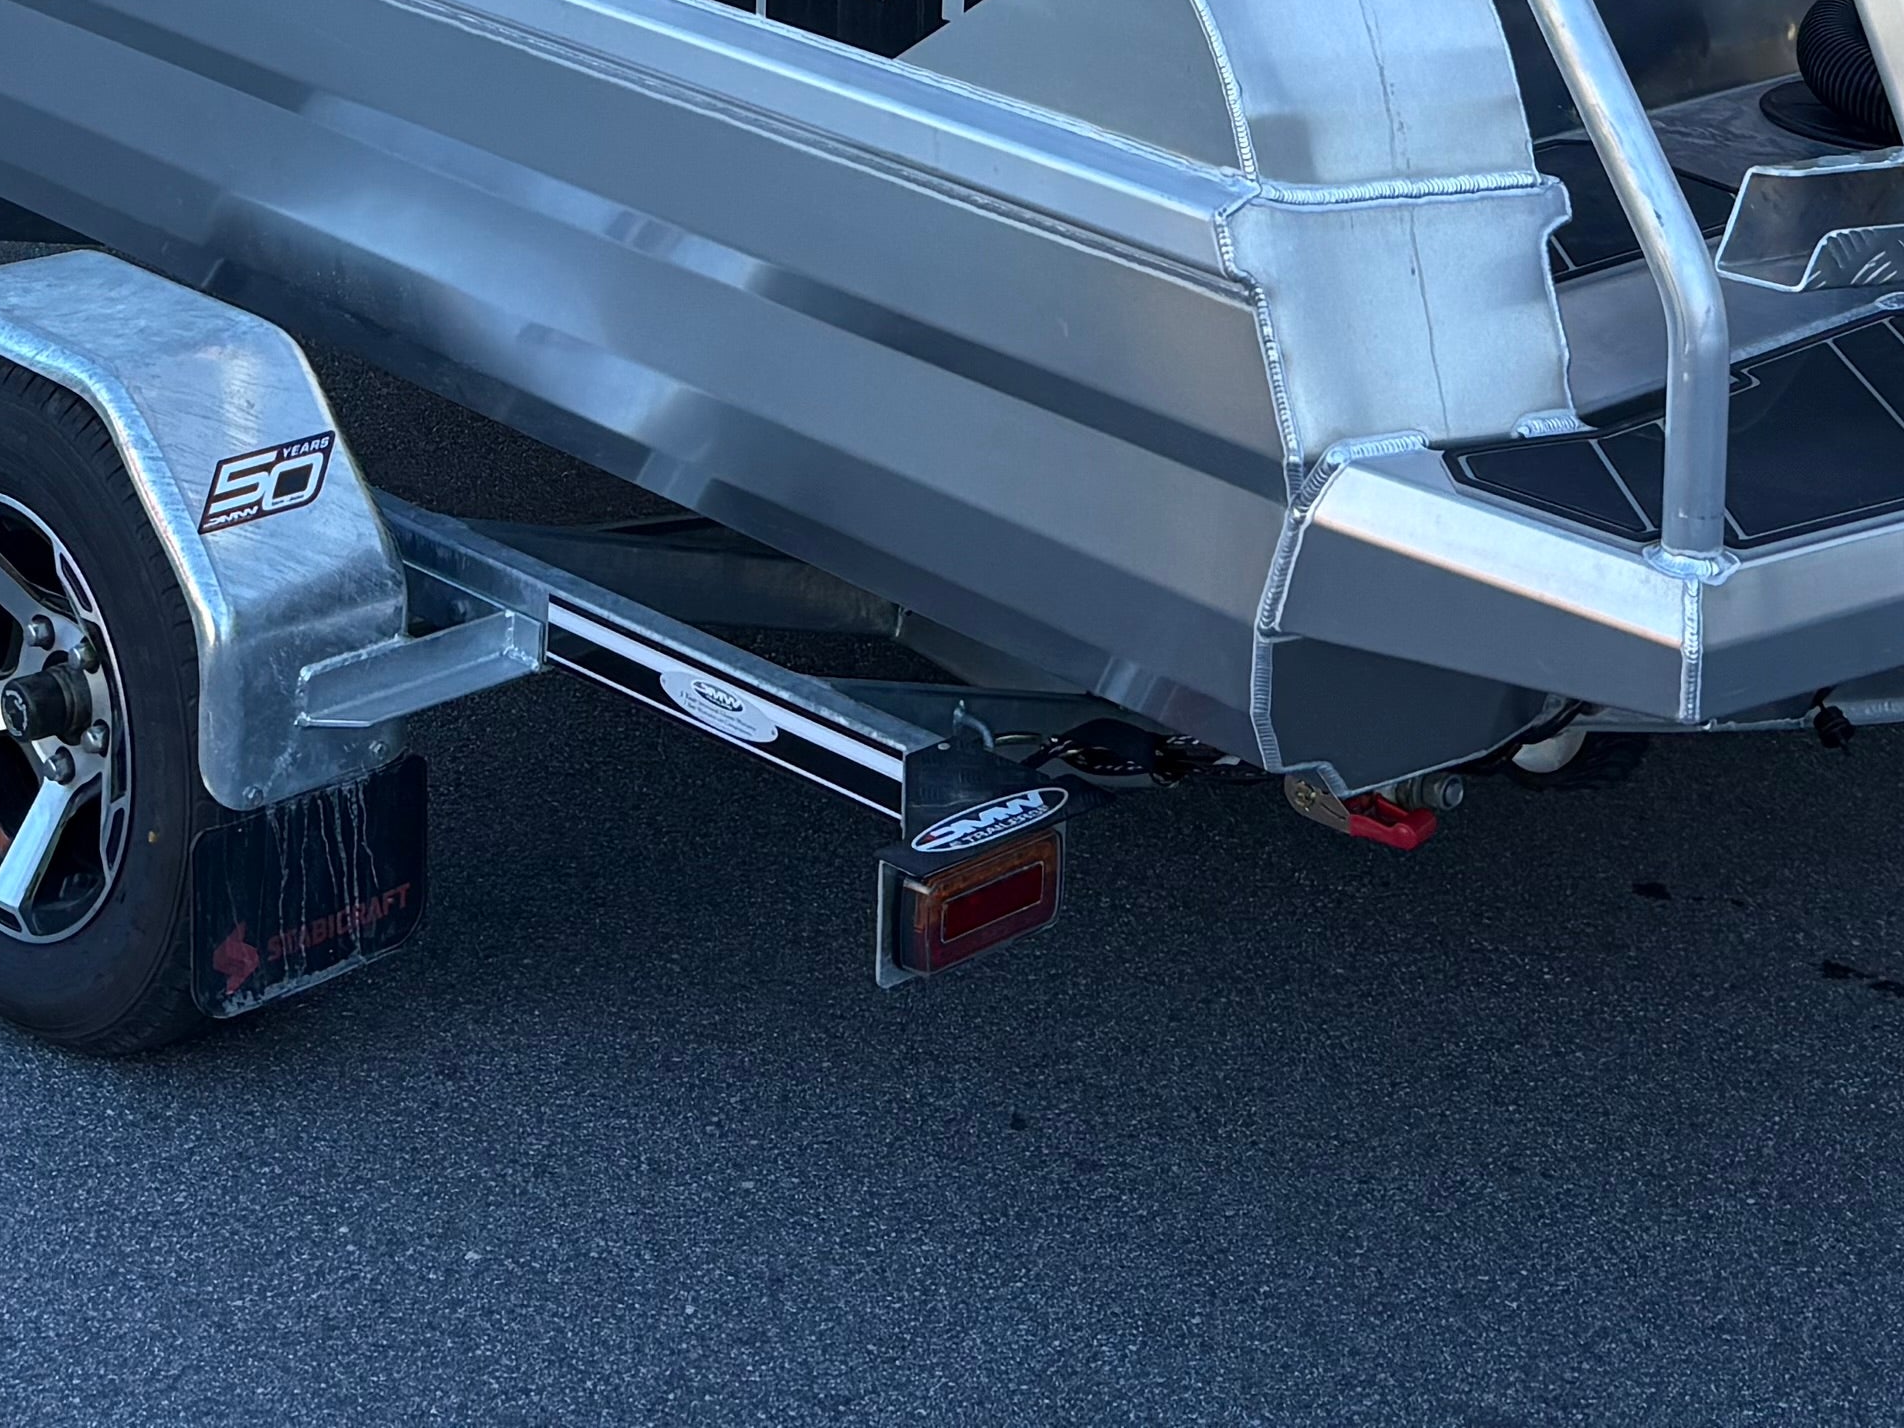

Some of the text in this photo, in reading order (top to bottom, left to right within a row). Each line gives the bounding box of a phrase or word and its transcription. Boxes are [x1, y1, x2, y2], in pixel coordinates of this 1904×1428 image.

[282, 436, 330, 458] YEARS
[209, 449, 324, 511] 50
[267, 881, 411, 961] STABICRAFT
